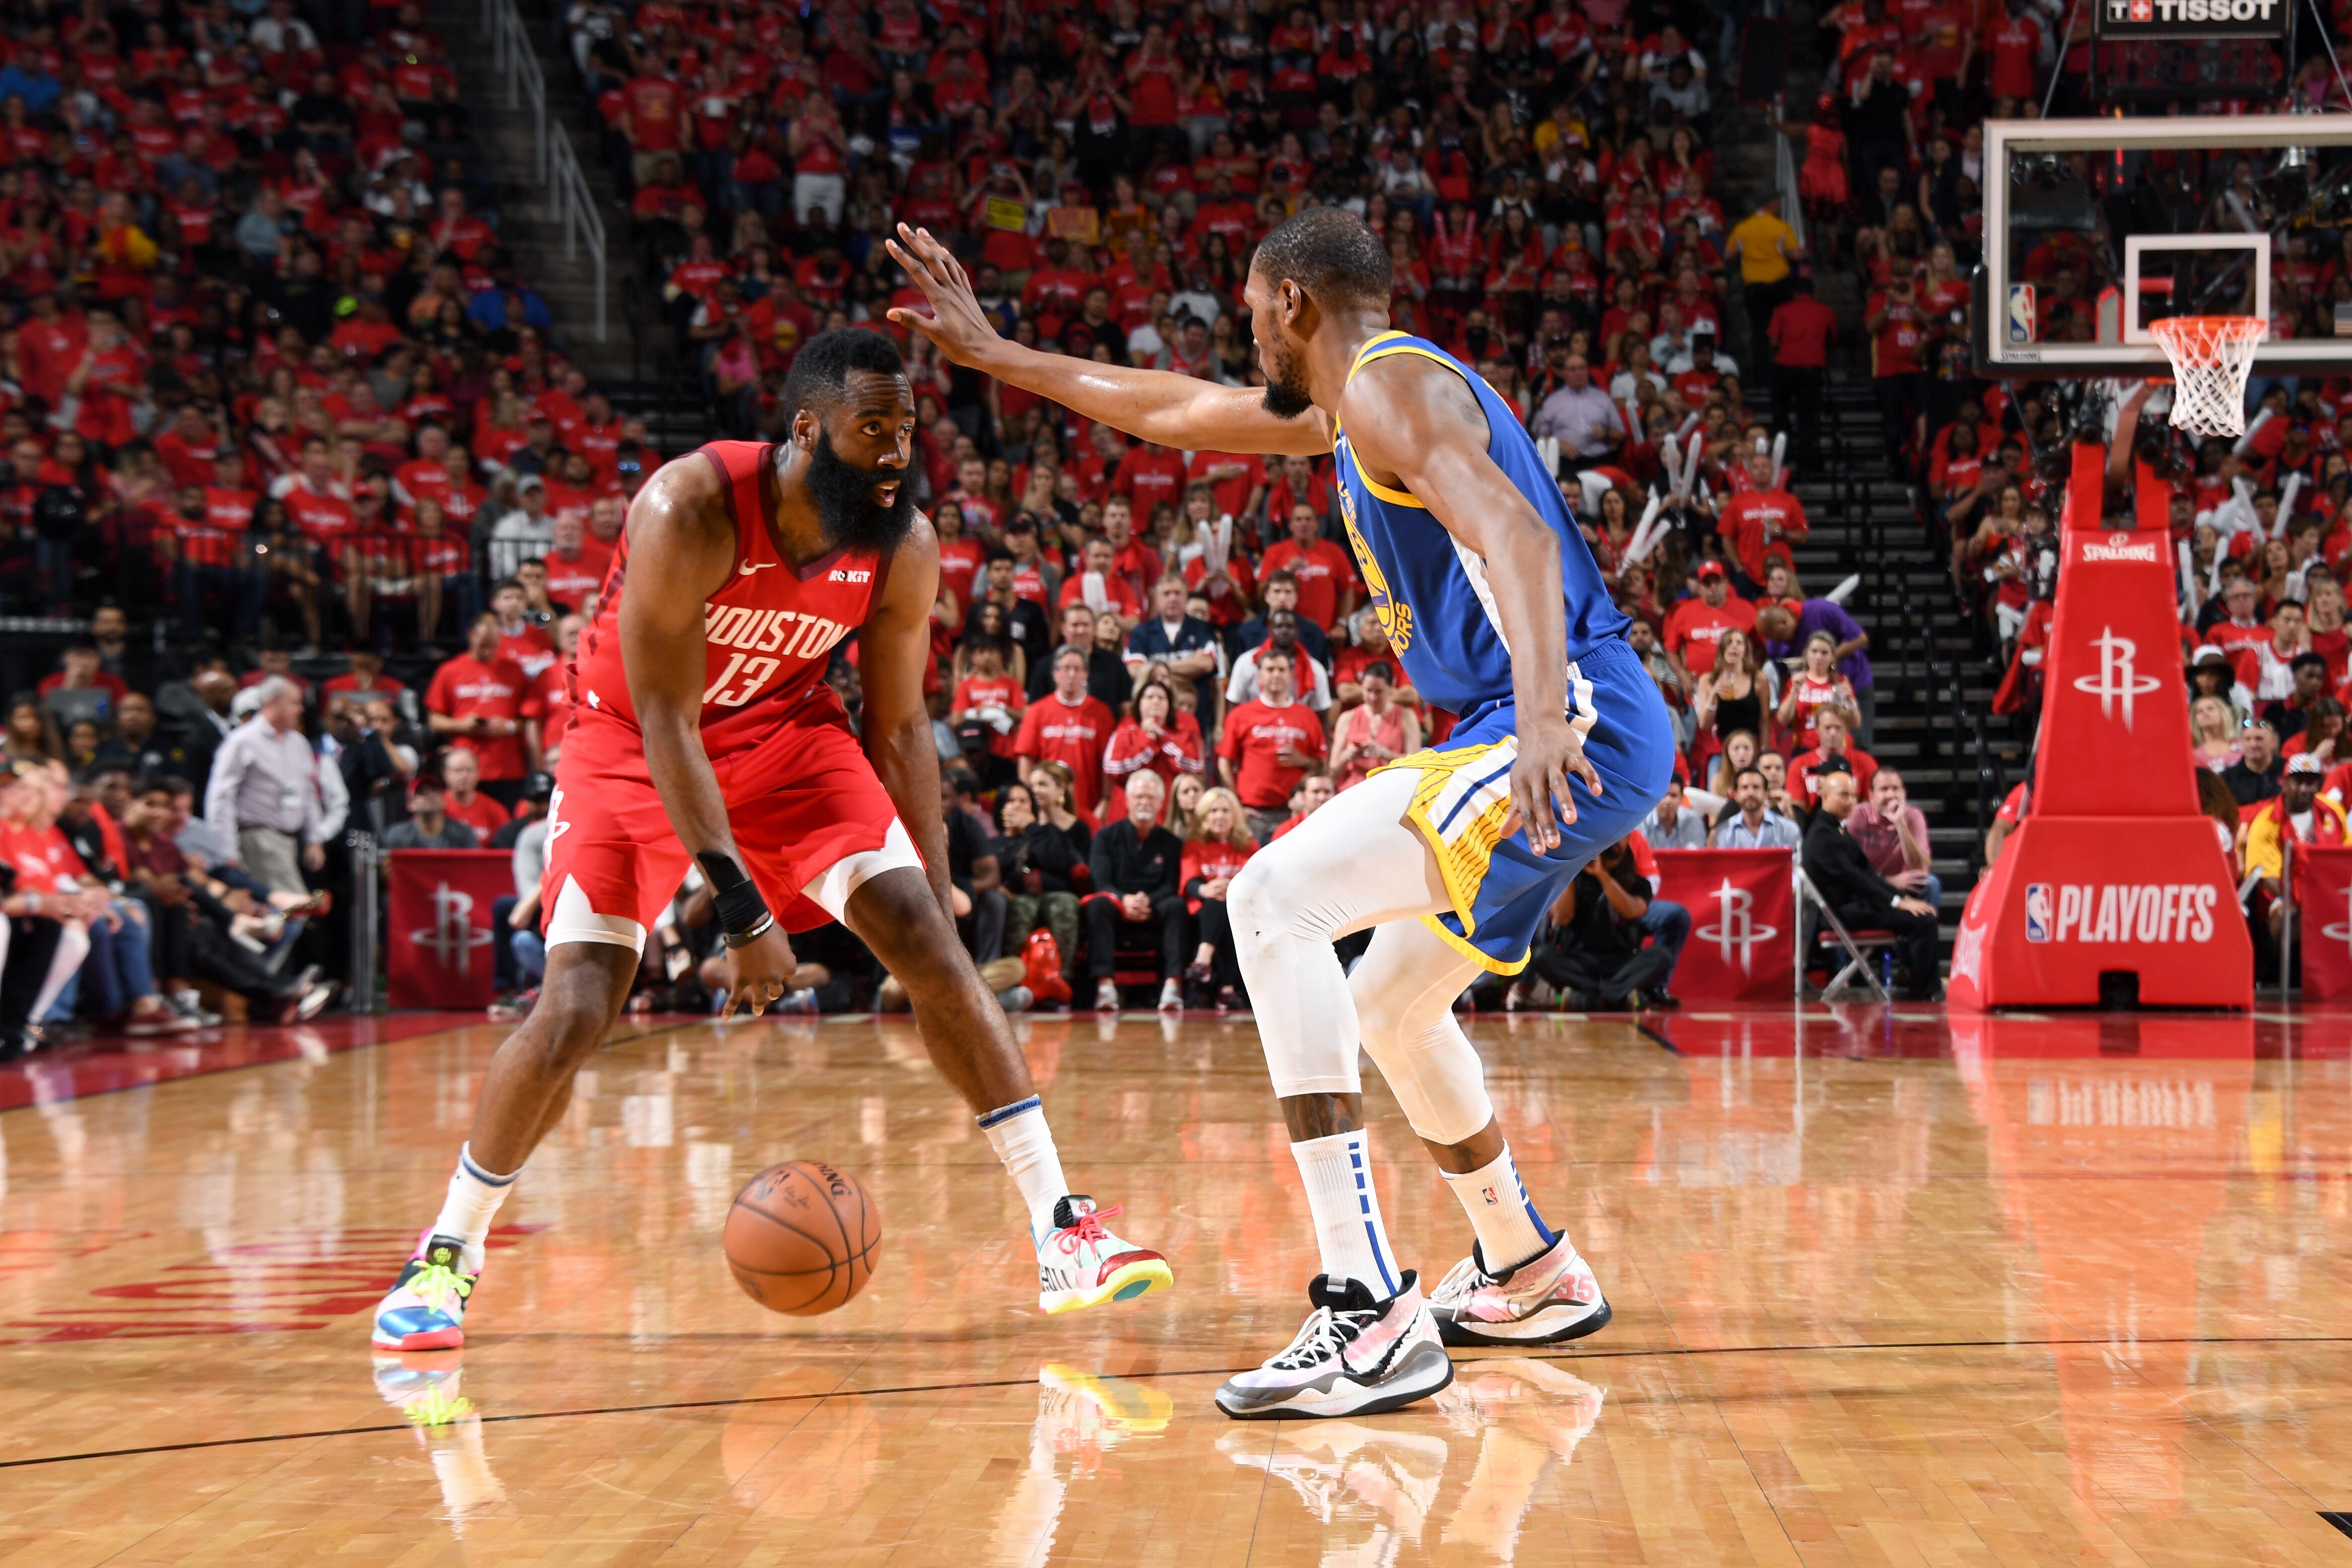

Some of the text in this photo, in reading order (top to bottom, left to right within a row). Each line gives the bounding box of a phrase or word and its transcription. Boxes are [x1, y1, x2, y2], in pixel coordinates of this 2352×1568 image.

[2155, 0, 2278, 21] TISSOT
[2082, 541, 2157, 563] SPALDING
[702, 652, 781, 707] 13
[2055, 884, 2217, 943] PLAYOFFS
[1556, 1273, 1595, 1302] 35
